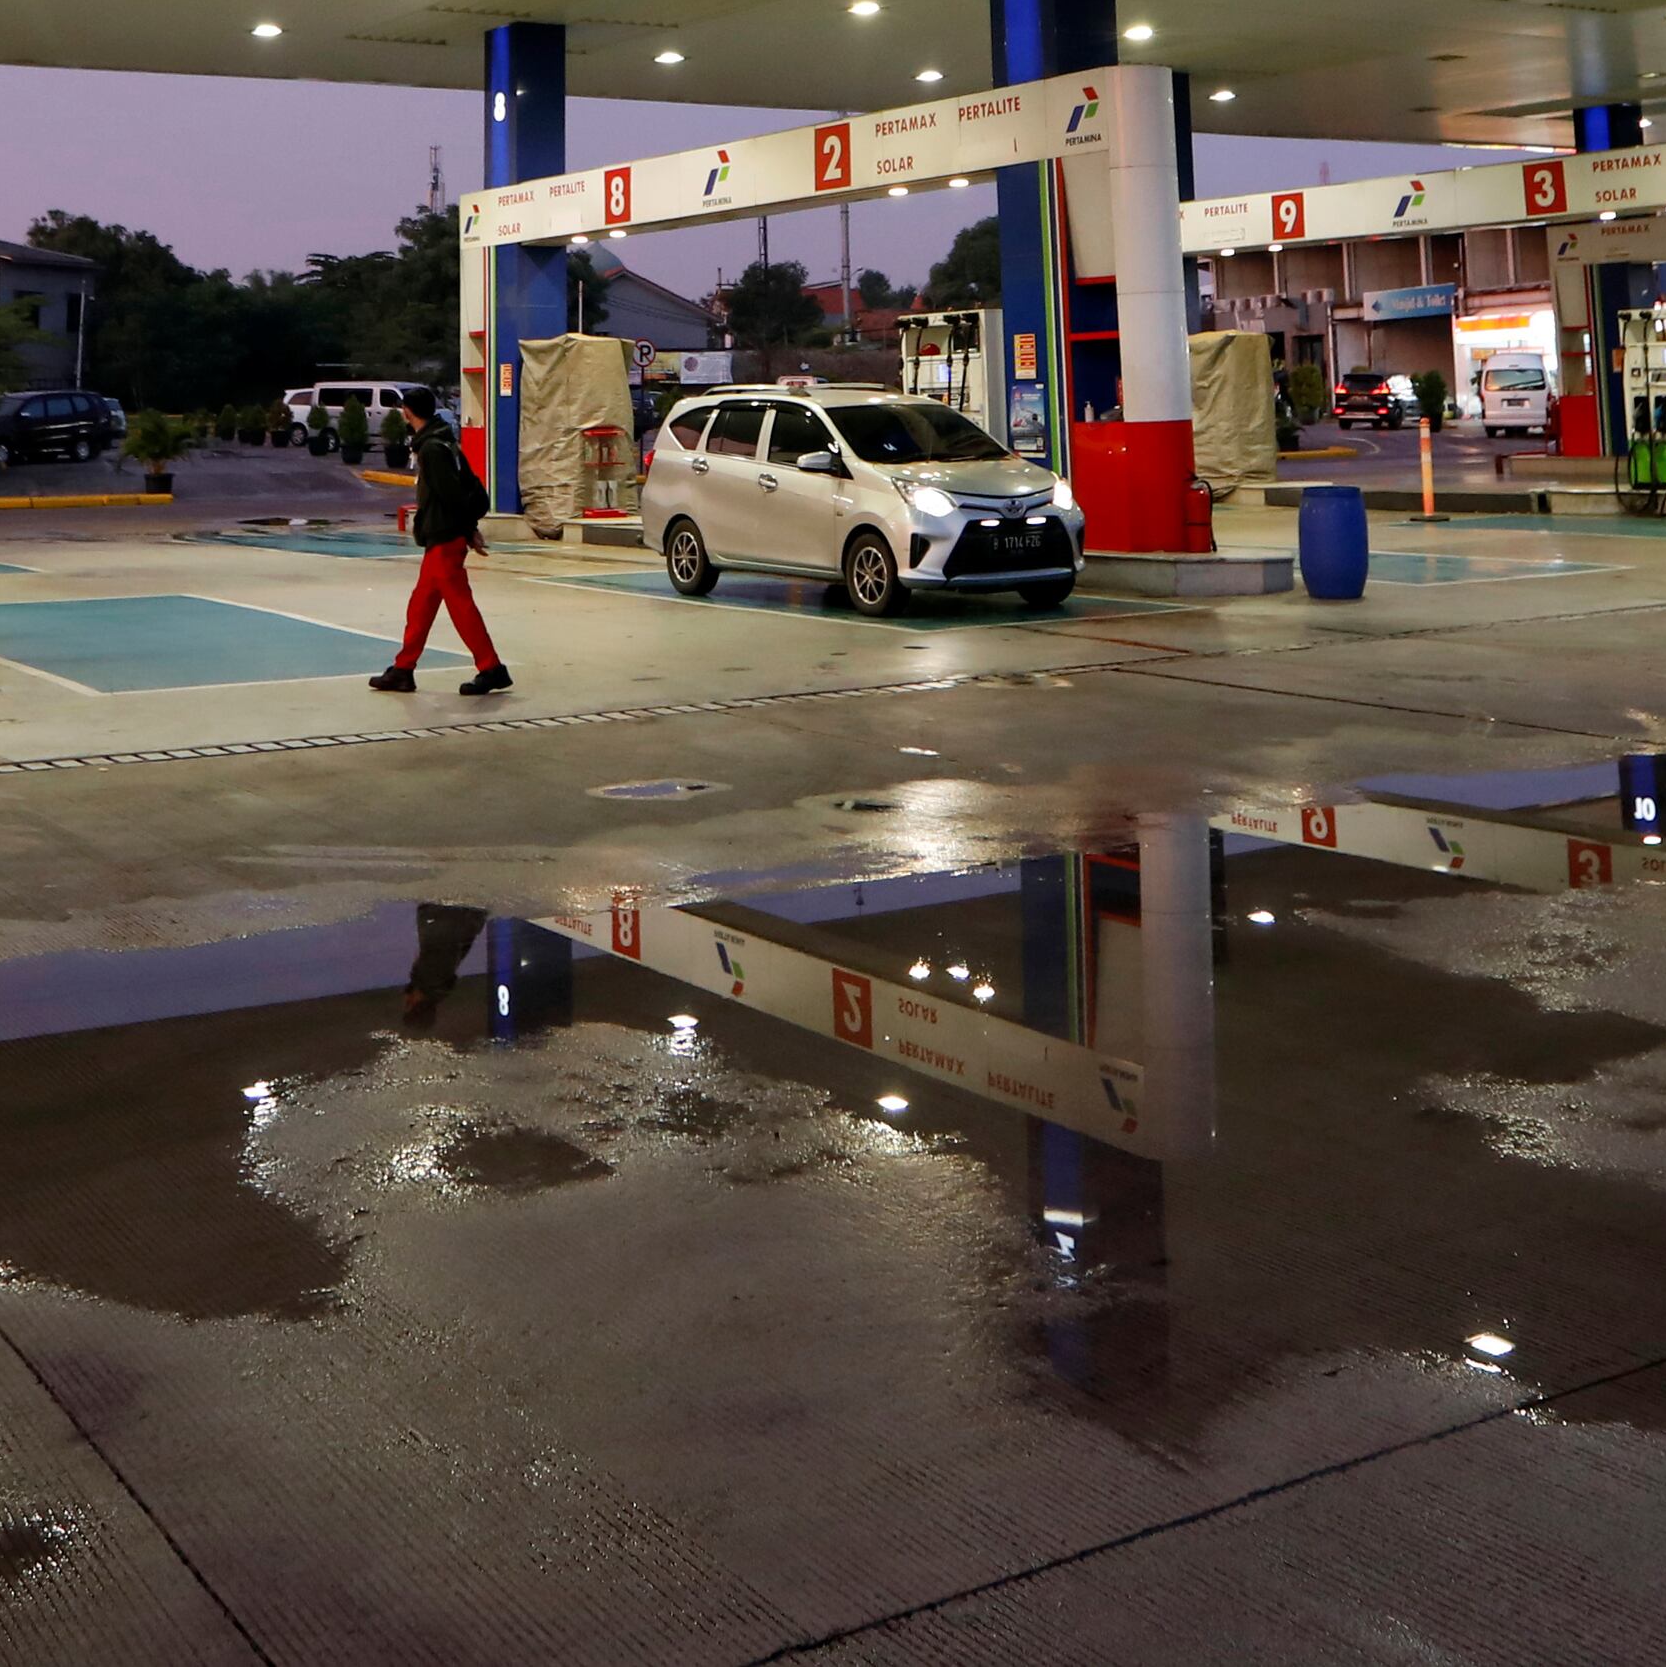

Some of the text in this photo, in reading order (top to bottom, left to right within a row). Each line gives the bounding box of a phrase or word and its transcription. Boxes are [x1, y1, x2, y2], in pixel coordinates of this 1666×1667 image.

[493, 91, 507, 122] 8
[875, 96, 1021, 137] PERTAMAX PERTALITE
[1065, 133, 1102, 147] PERTAMINA
[822, 135, 842, 181] 2
[876, 156, 914, 175] SOLAR
[1592, 153, 1661, 173] PERTAMAX
[498, 180, 586, 207] PERTAMAX PERTALITE
[609, 175, 625, 216] 8
[1533, 169, 1556, 208] 3
[1595, 187, 1637, 202] SOLAR
[1204, 203, 1249, 217] PERTALITE
[1279, 199, 1297, 234] 9
[498, 222, 521, 236] SOLAR
